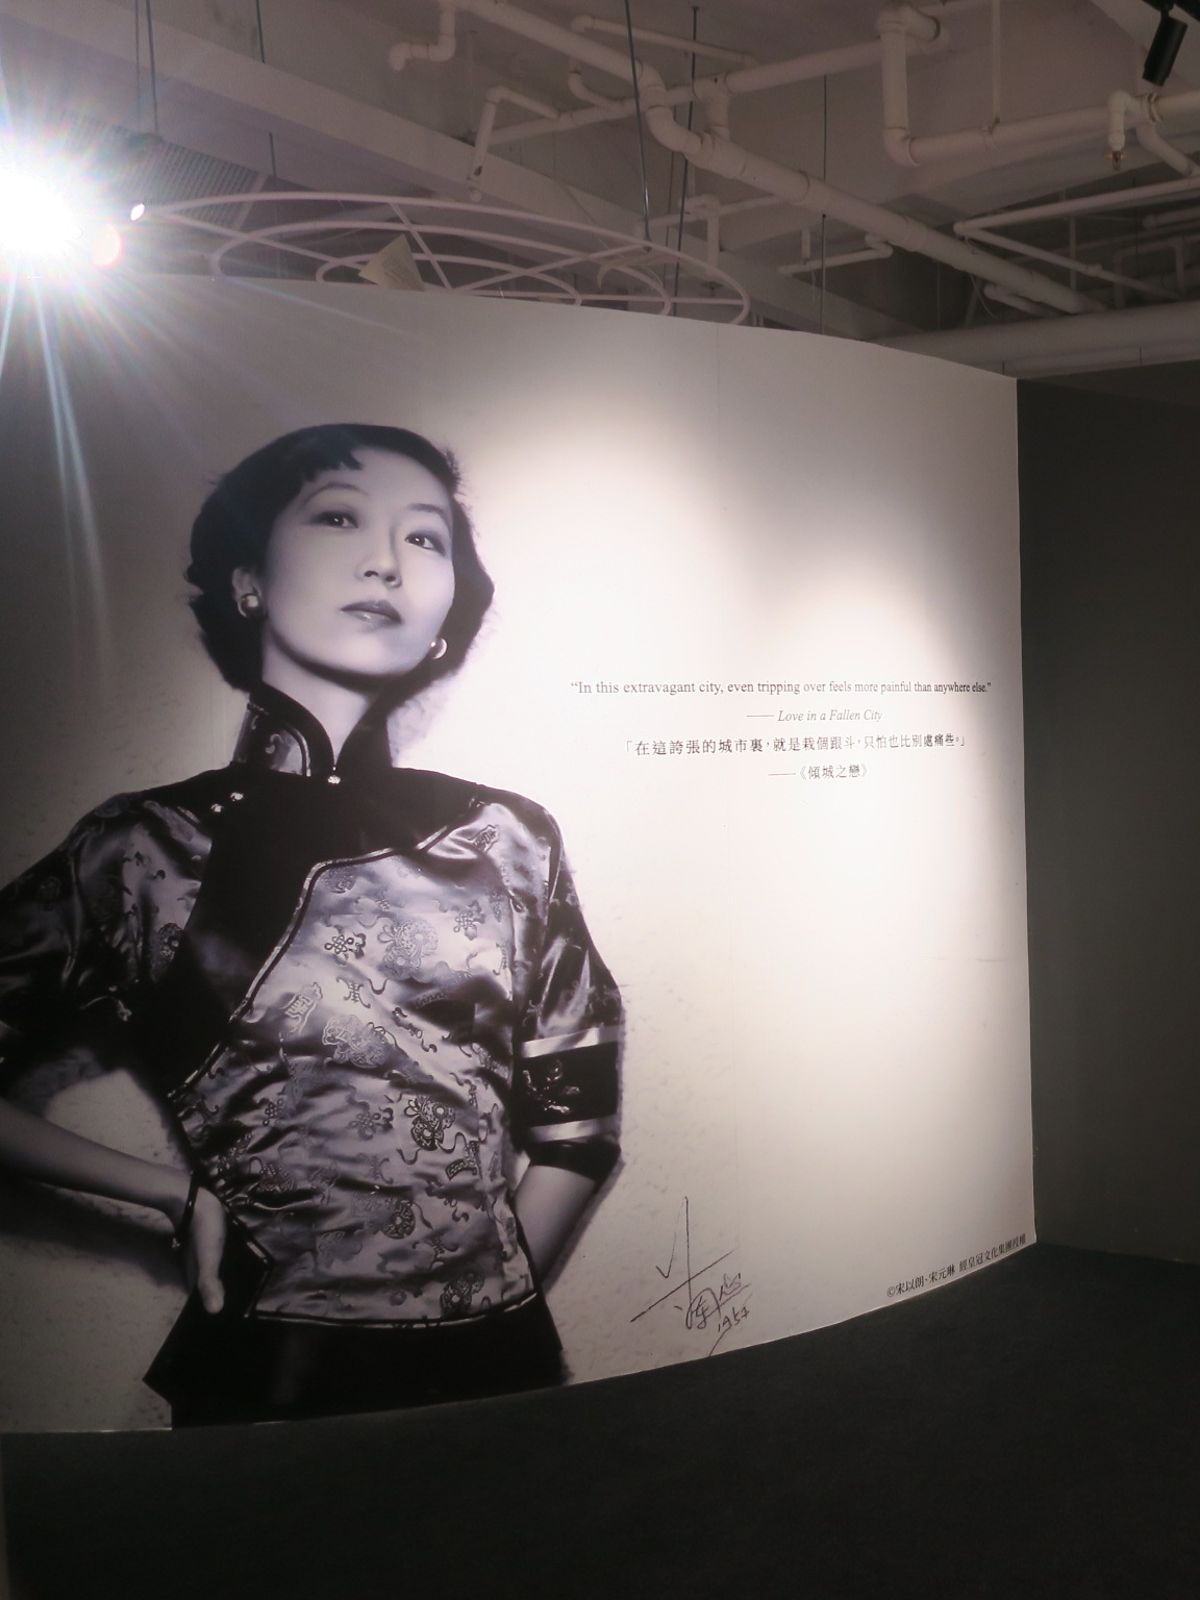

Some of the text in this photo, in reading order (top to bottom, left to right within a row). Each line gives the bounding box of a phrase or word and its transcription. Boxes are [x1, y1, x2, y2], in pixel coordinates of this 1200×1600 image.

[596, 681, 619, 694] this
[623, 681, 695, 696] extravagant
[699, 681, 724, 695] city,
[727, 683, 754, 693] even
[757, 681, 800, 695] tripping
[803, 682, 826, 693] over
[829, 681, 852, 693] feels
[854, 682, 878, 693] more
[880, 681, 912, 695] painful
[914, 681, 932, 693] than
[934, 681, 970, 695] anywhere
[777, 710, 804, 722] Love
[807, 710, 817, 721] in
[819, 713, 826, 721] a
[829, 709, 861, 721] Fallen
[863, 709, 883, 723] City
